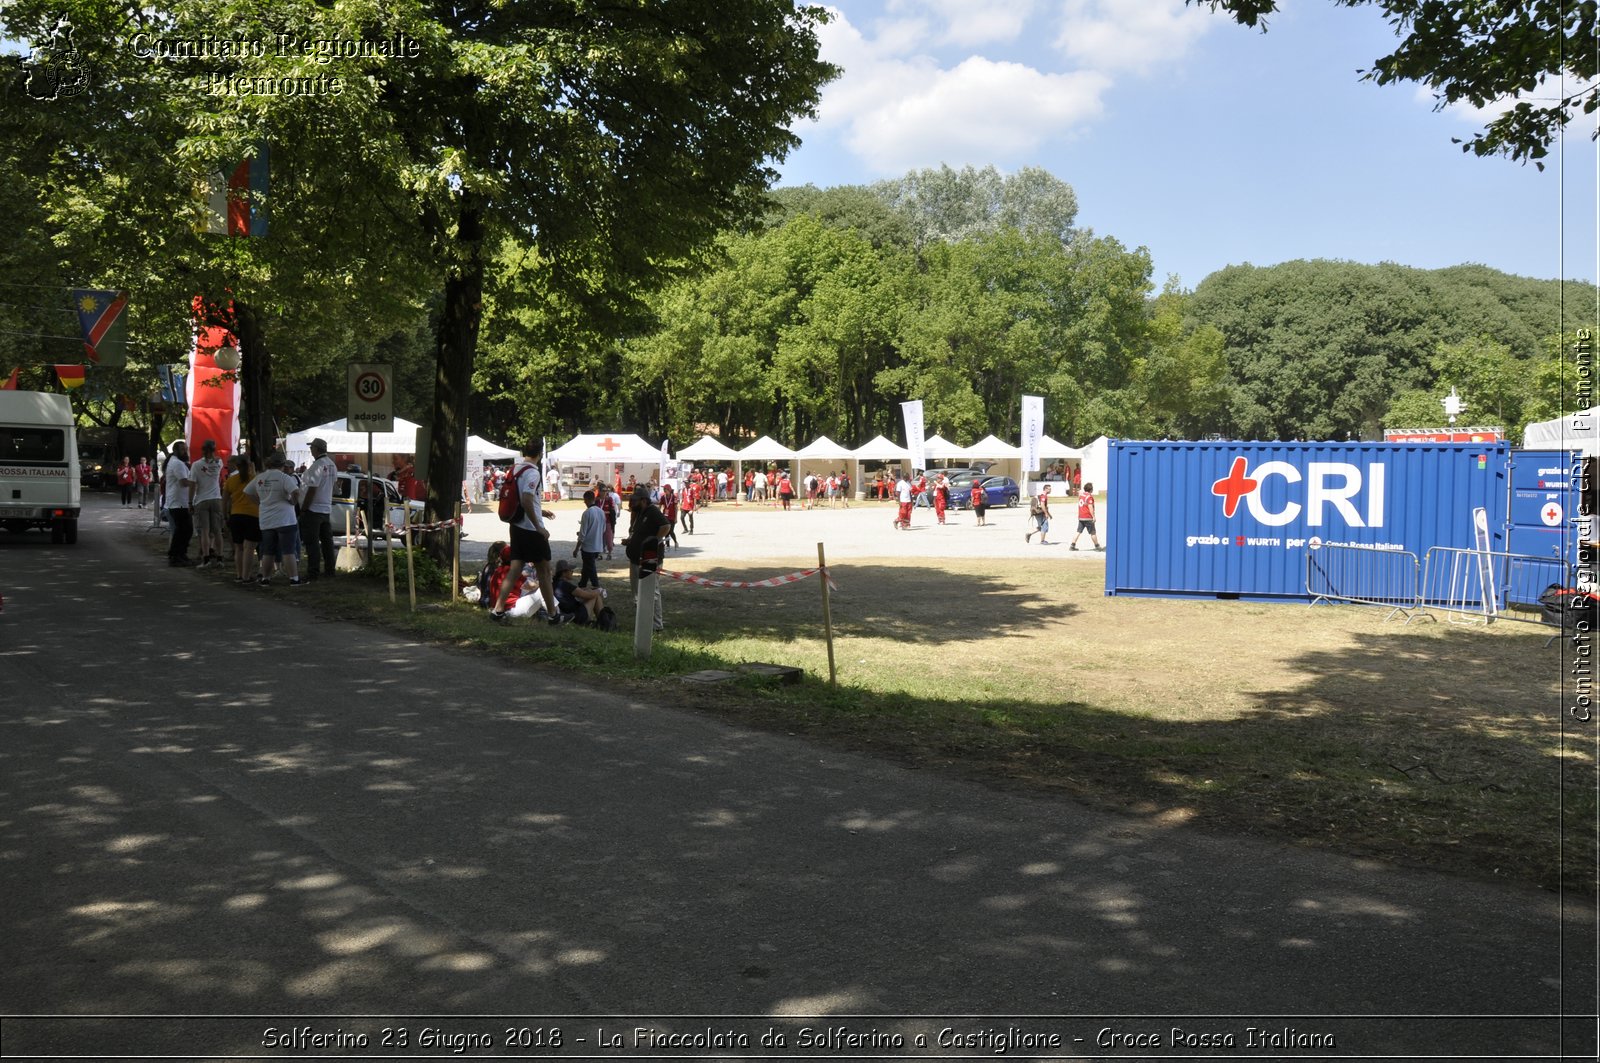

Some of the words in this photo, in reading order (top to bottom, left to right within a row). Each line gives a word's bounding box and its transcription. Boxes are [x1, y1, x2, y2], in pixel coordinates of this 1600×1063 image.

[362, 380, 380, 394] 30
[354, 412, 386, 421] adagio
[29, 469, 66, 477] ITALIANA
[1538, 466, 1562, 477] grazie
[1246, 460, 1385, 528] CRI
[1186, 534, 1220, 547] grazie
[1221, 537, 1229, 545] a
[1286, 538, 1306, 549] per
[1349, 541, 1375, 550] Rossa
[1375, 542, 1404, 551] Italiana
